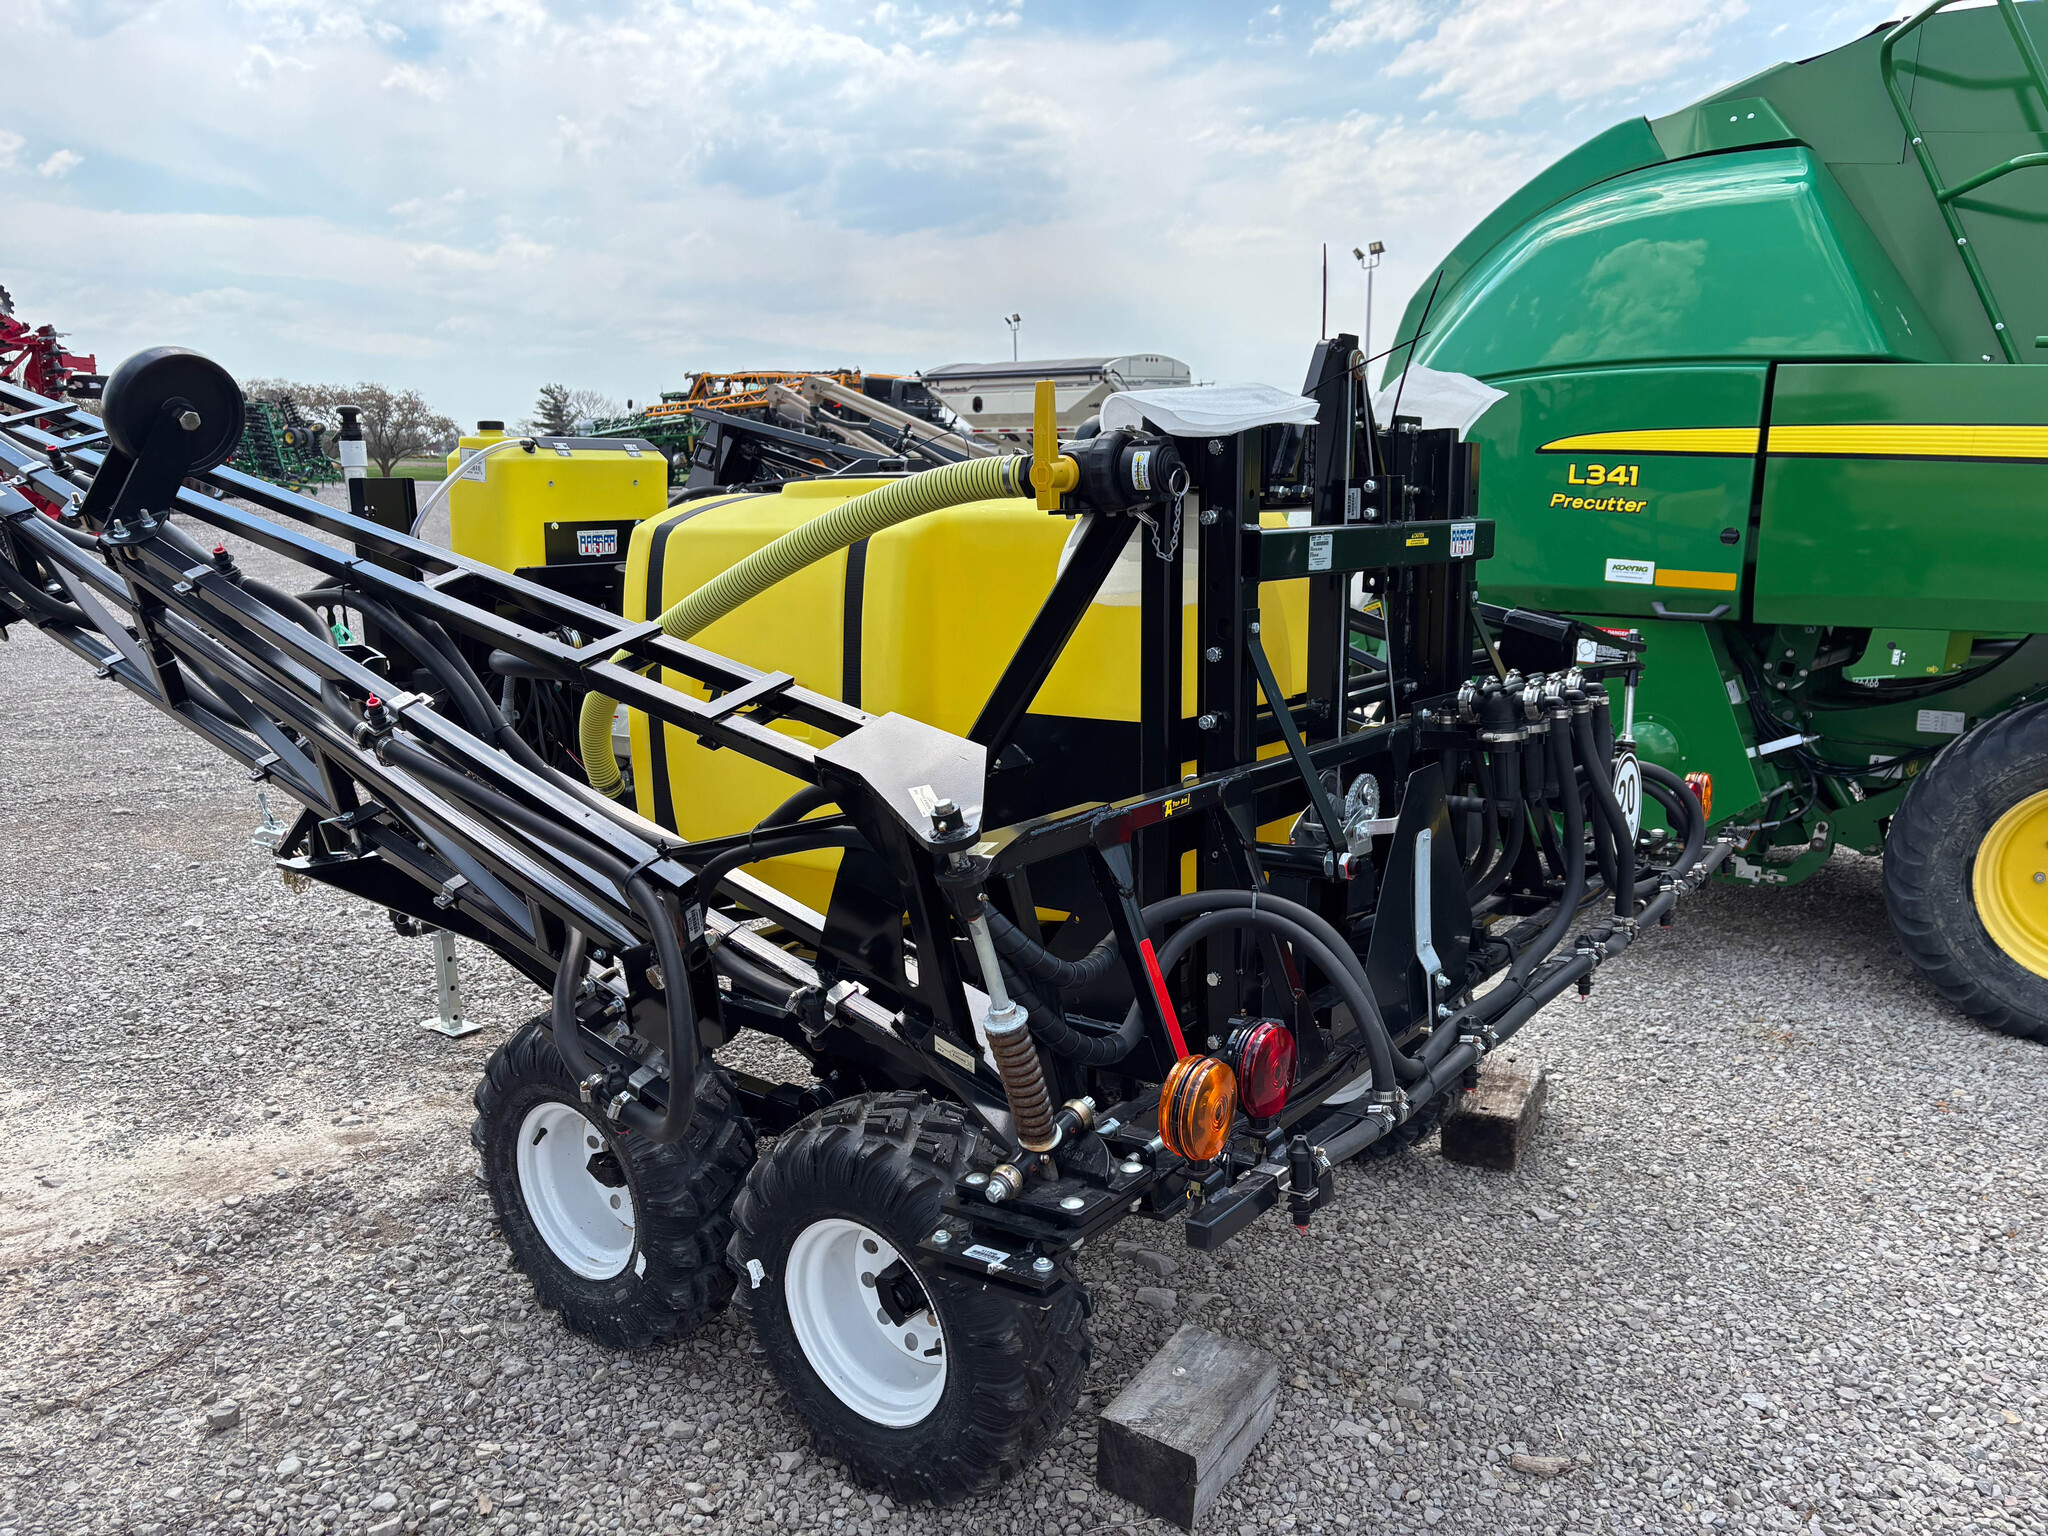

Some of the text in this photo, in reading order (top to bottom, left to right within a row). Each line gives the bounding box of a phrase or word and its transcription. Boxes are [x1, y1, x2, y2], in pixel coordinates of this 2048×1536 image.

[1567, 463, 1640, 487] L341
[1549, 493, 1648, 513] Precutter
[1618, 773, 1635, 816] 20
